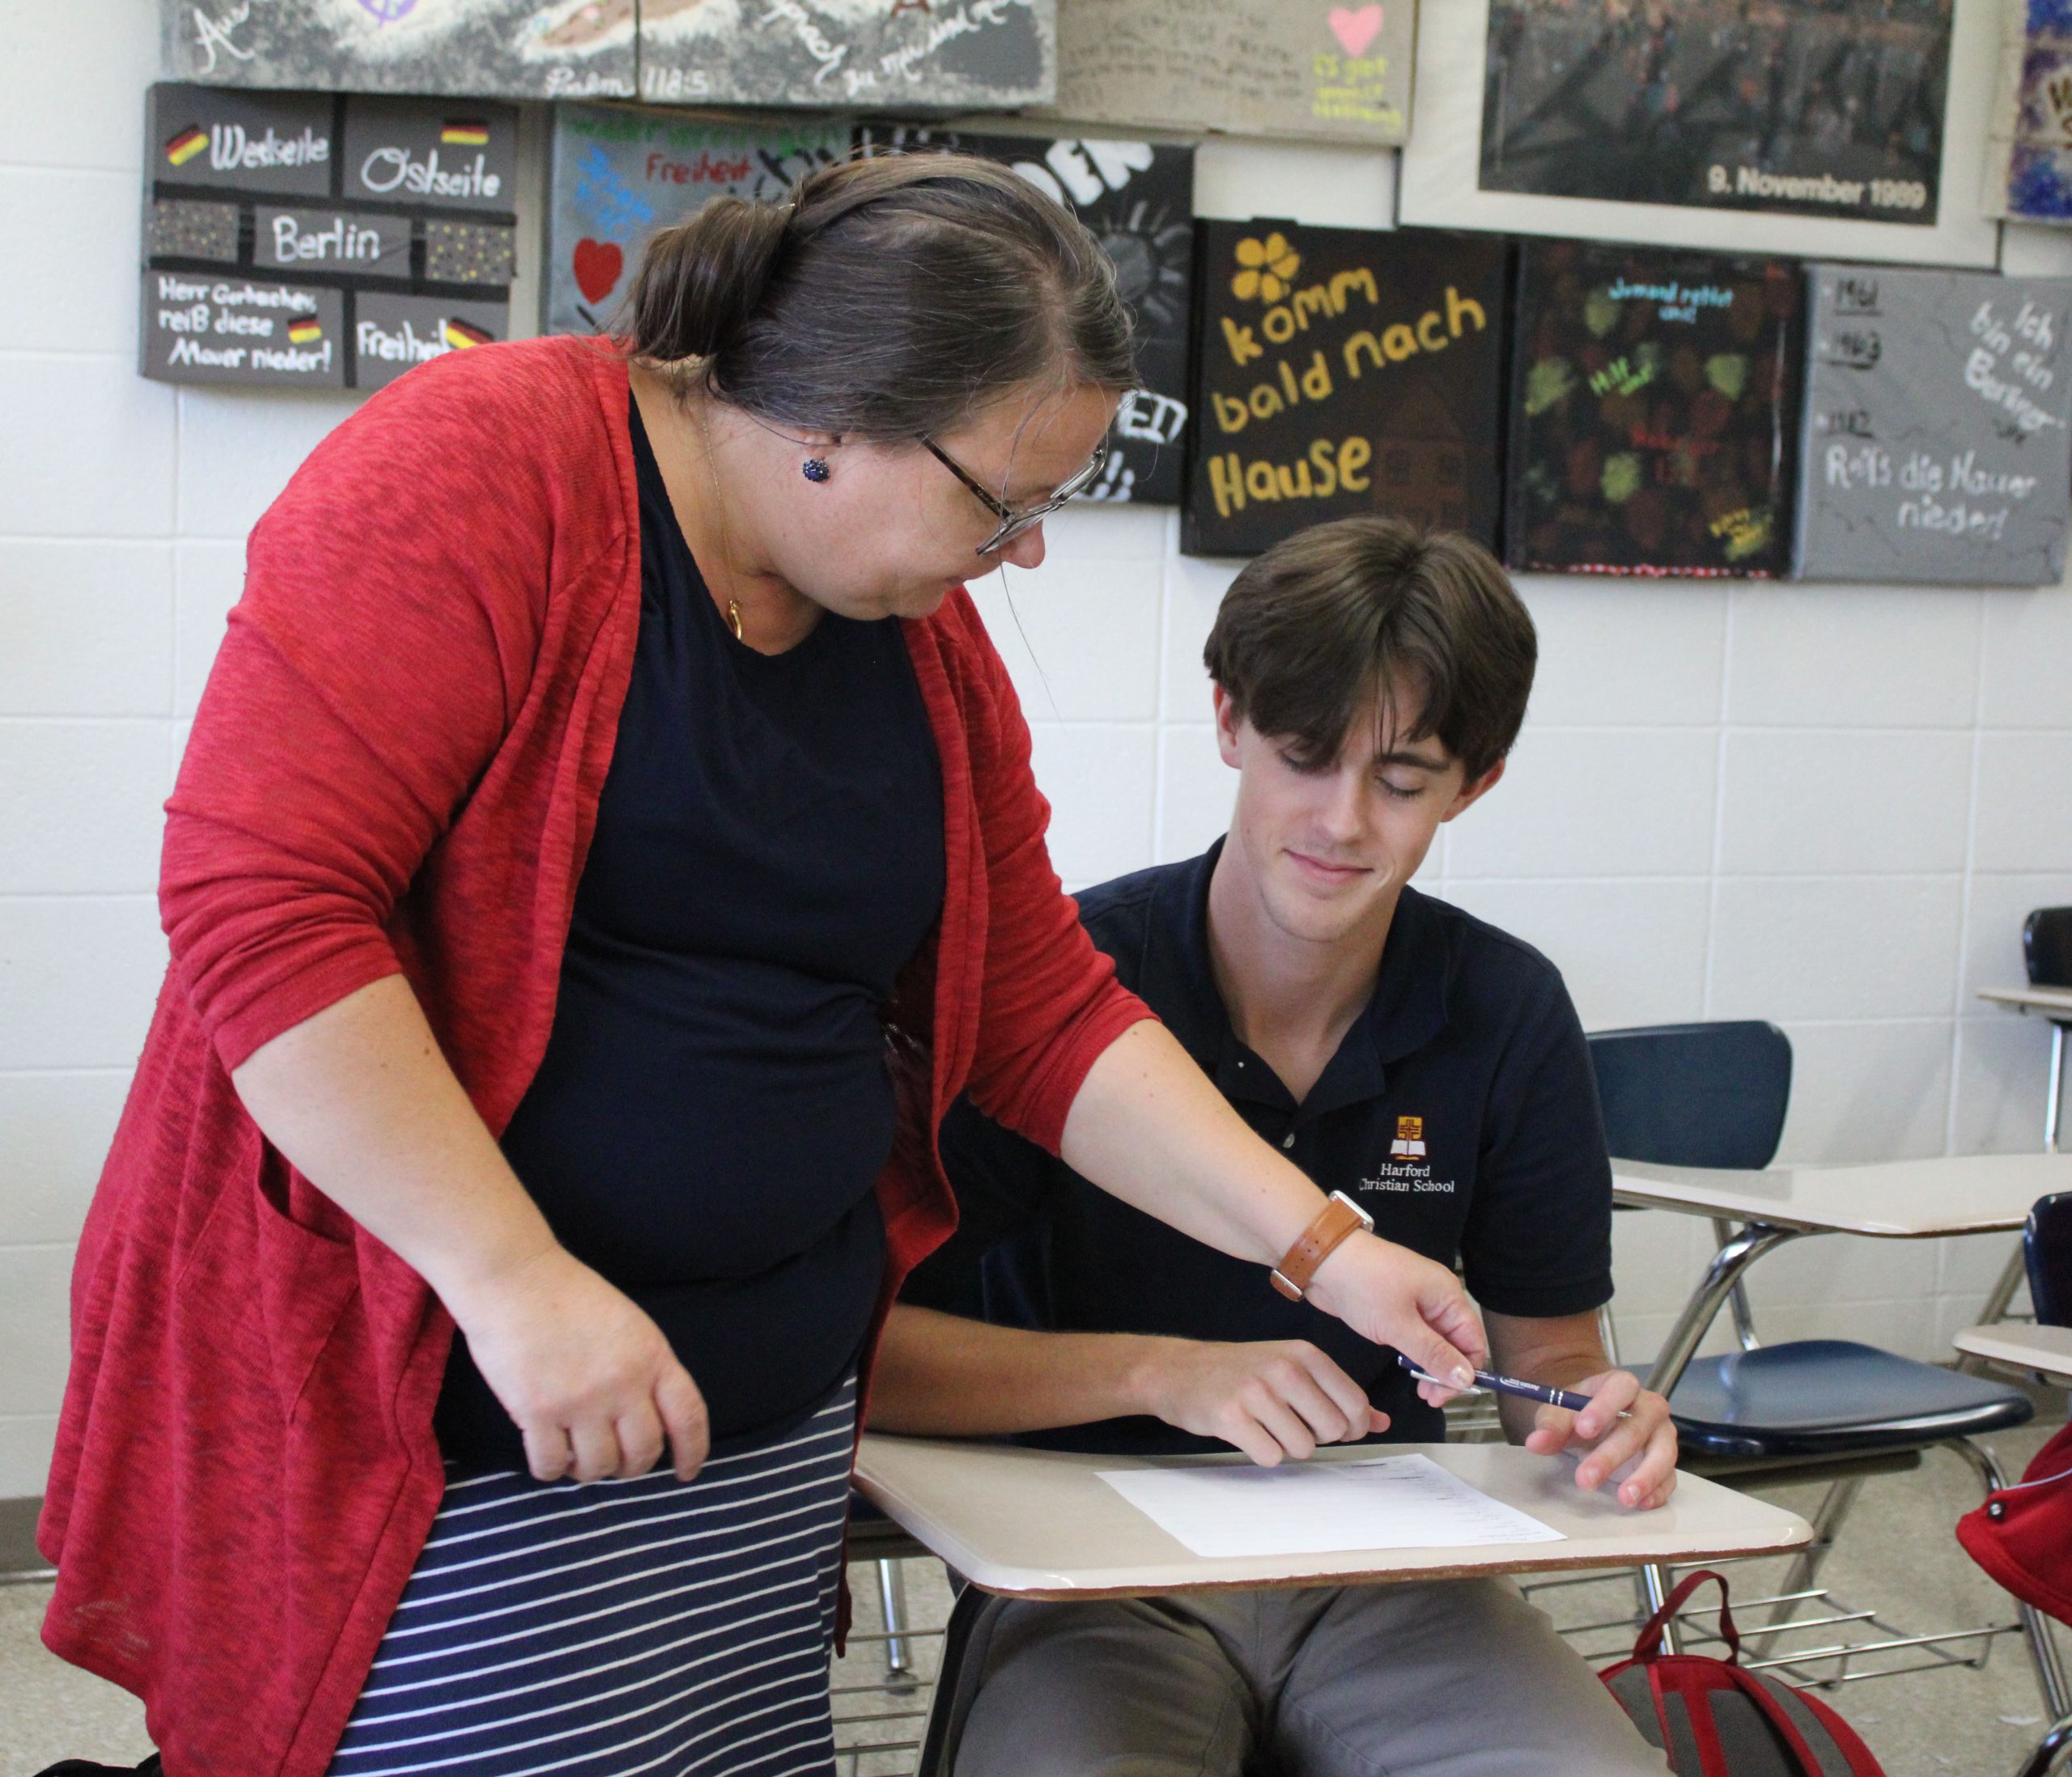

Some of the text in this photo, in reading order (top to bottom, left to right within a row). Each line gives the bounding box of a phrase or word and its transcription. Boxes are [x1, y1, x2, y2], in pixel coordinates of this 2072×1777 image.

[361, 146, 500, 197] Ostseite
[1708, 164, 1927, 210] 9. November 1989
[273, 214, 380, 262] Berlin
[159, 275, 210, 302] Herr
[214, 307, 274, 337] diese
[1221, 268, 1378, 366] komm
[168, 337, 331, 372] Mauer nieder!
[1212, 350, 1333, 433] bald
[1342, 286, 1486, 378] nach
[1208, 436, 1371, 518] Hause
[1900, 450, 1943, 493] die
[1948, 447, 2036, 499] Mauer
[1360, 1178, 1455, 1193] Christian School
[1380, 1163, 1430, 1177] Harford
